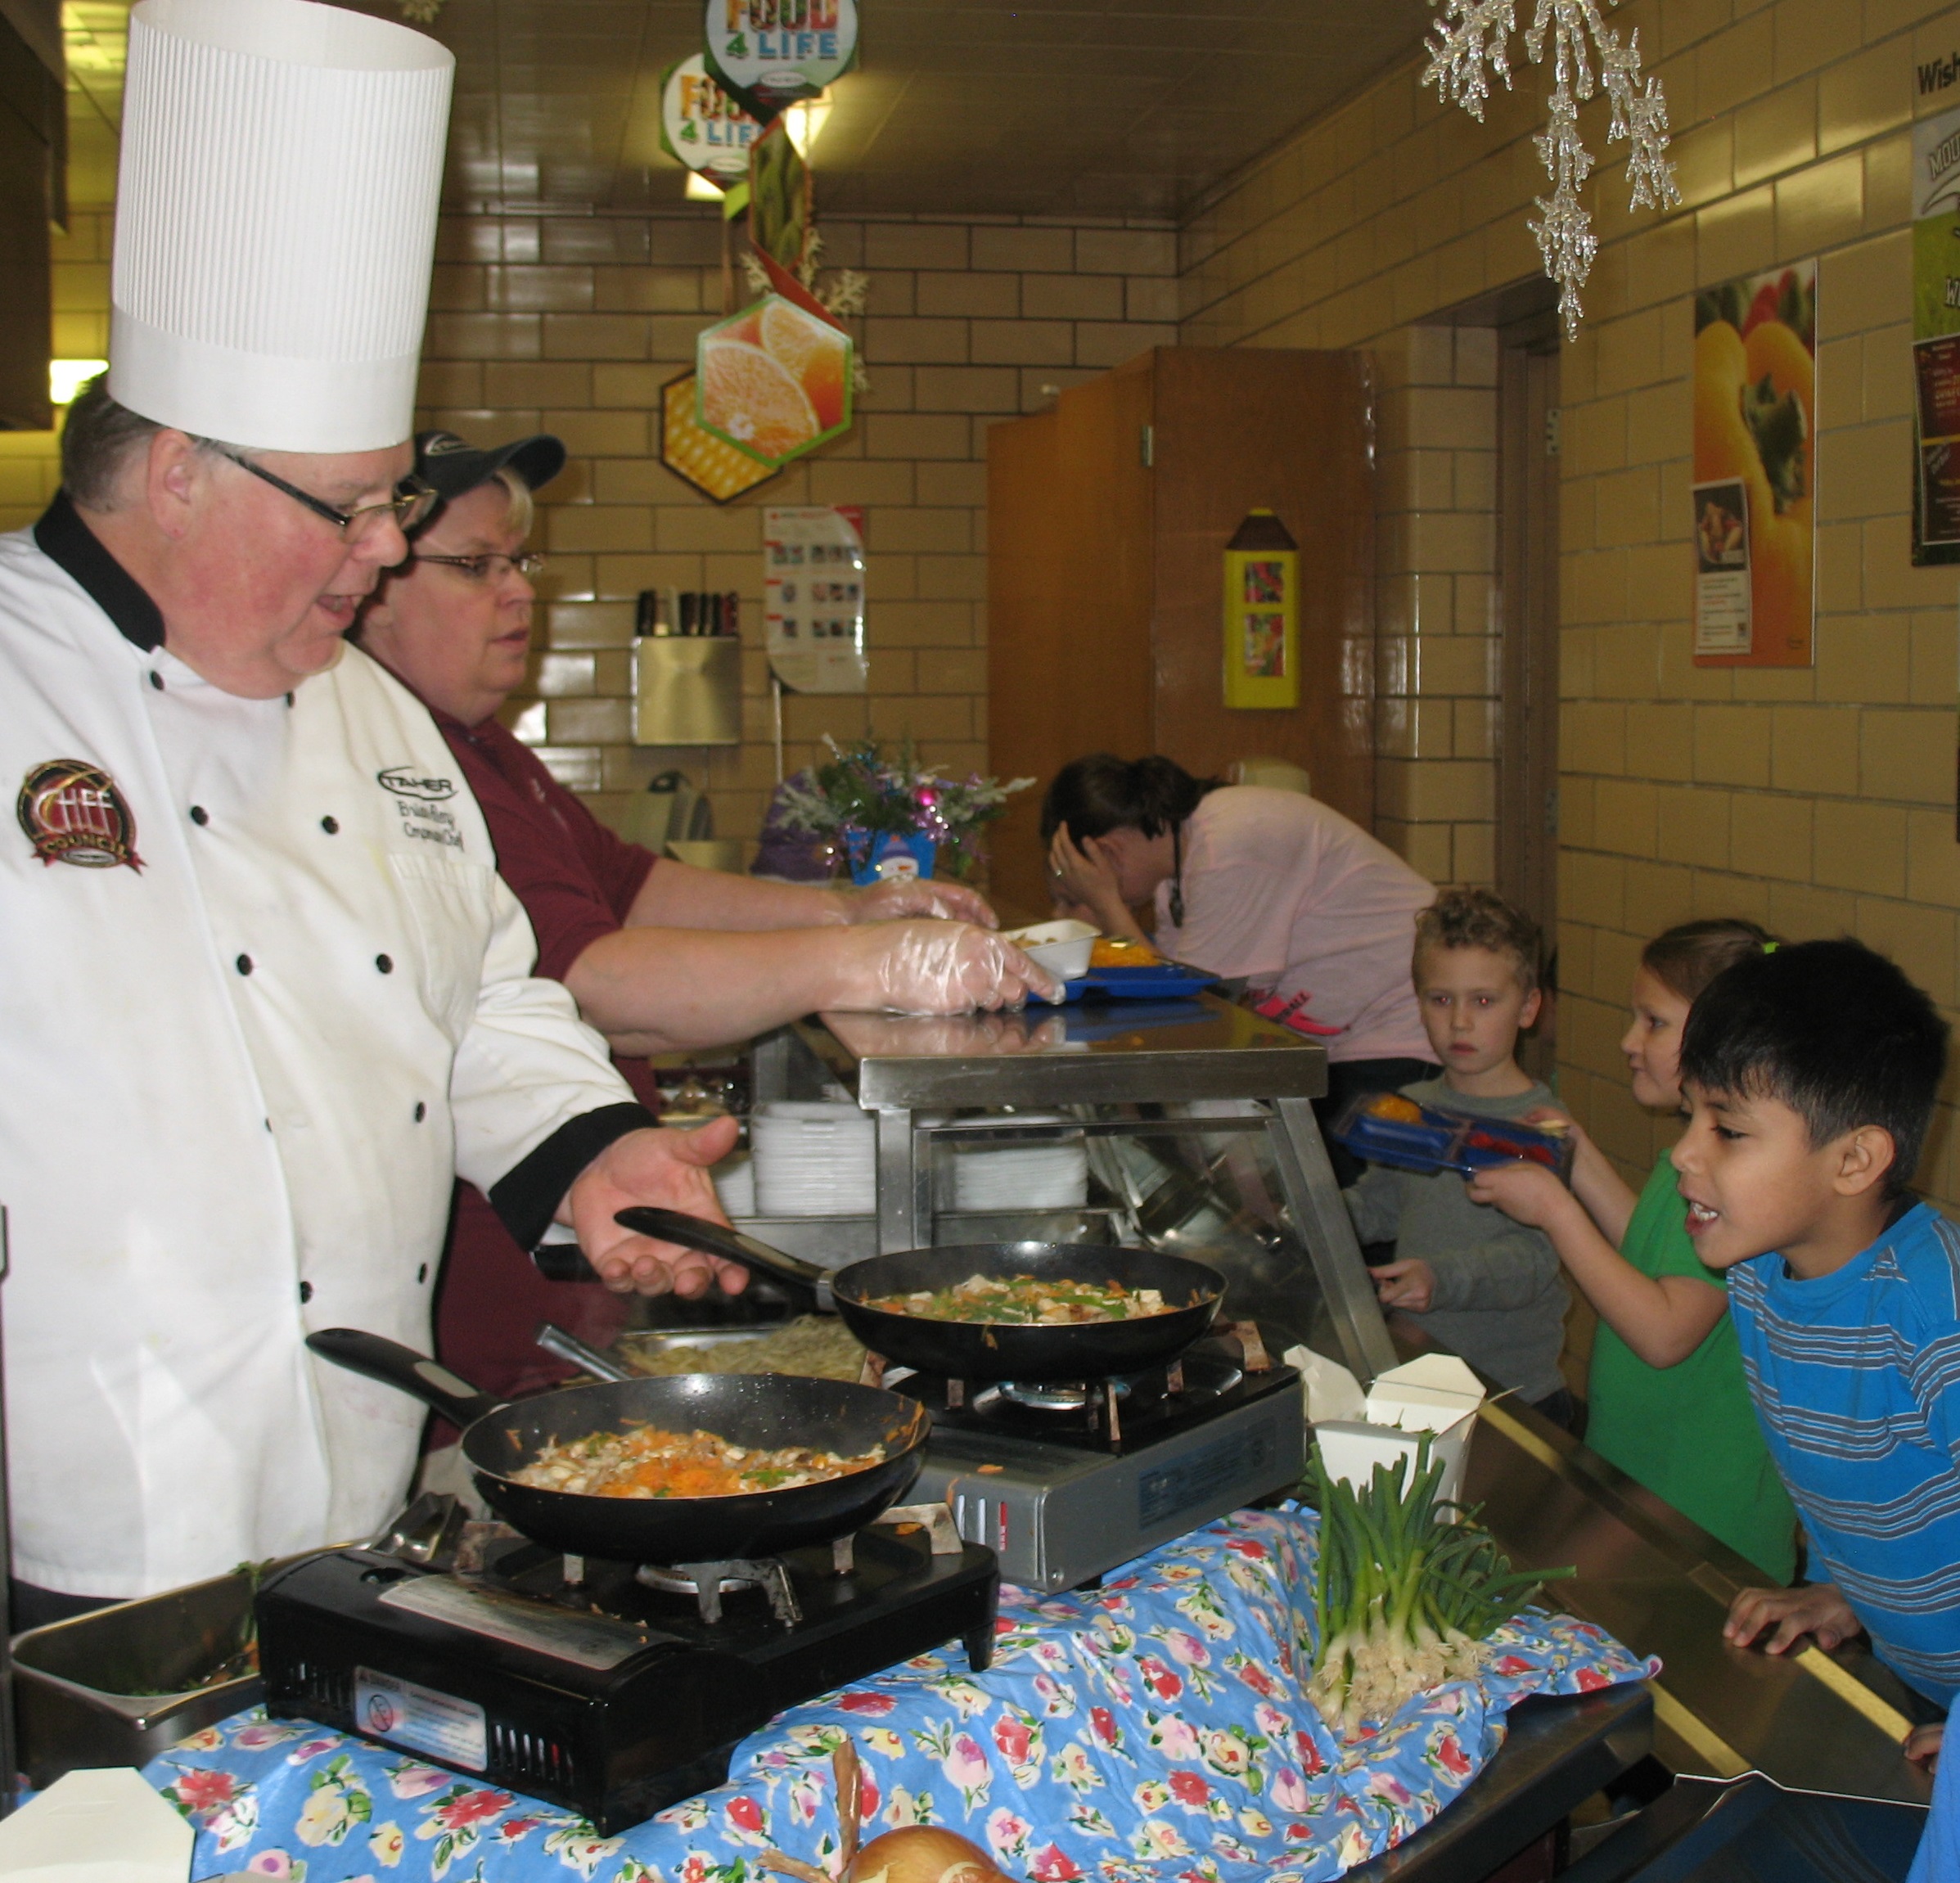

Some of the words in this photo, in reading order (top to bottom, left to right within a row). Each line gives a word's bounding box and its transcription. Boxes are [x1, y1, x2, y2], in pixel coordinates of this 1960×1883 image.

[725, 0, 839, 33] FOOD
[725, 32, 749, 57] 4
[758, 32, 839, 59] LIFE
[680, 119, 699, 143] 4
[706, 121, 764, 147] LIF
